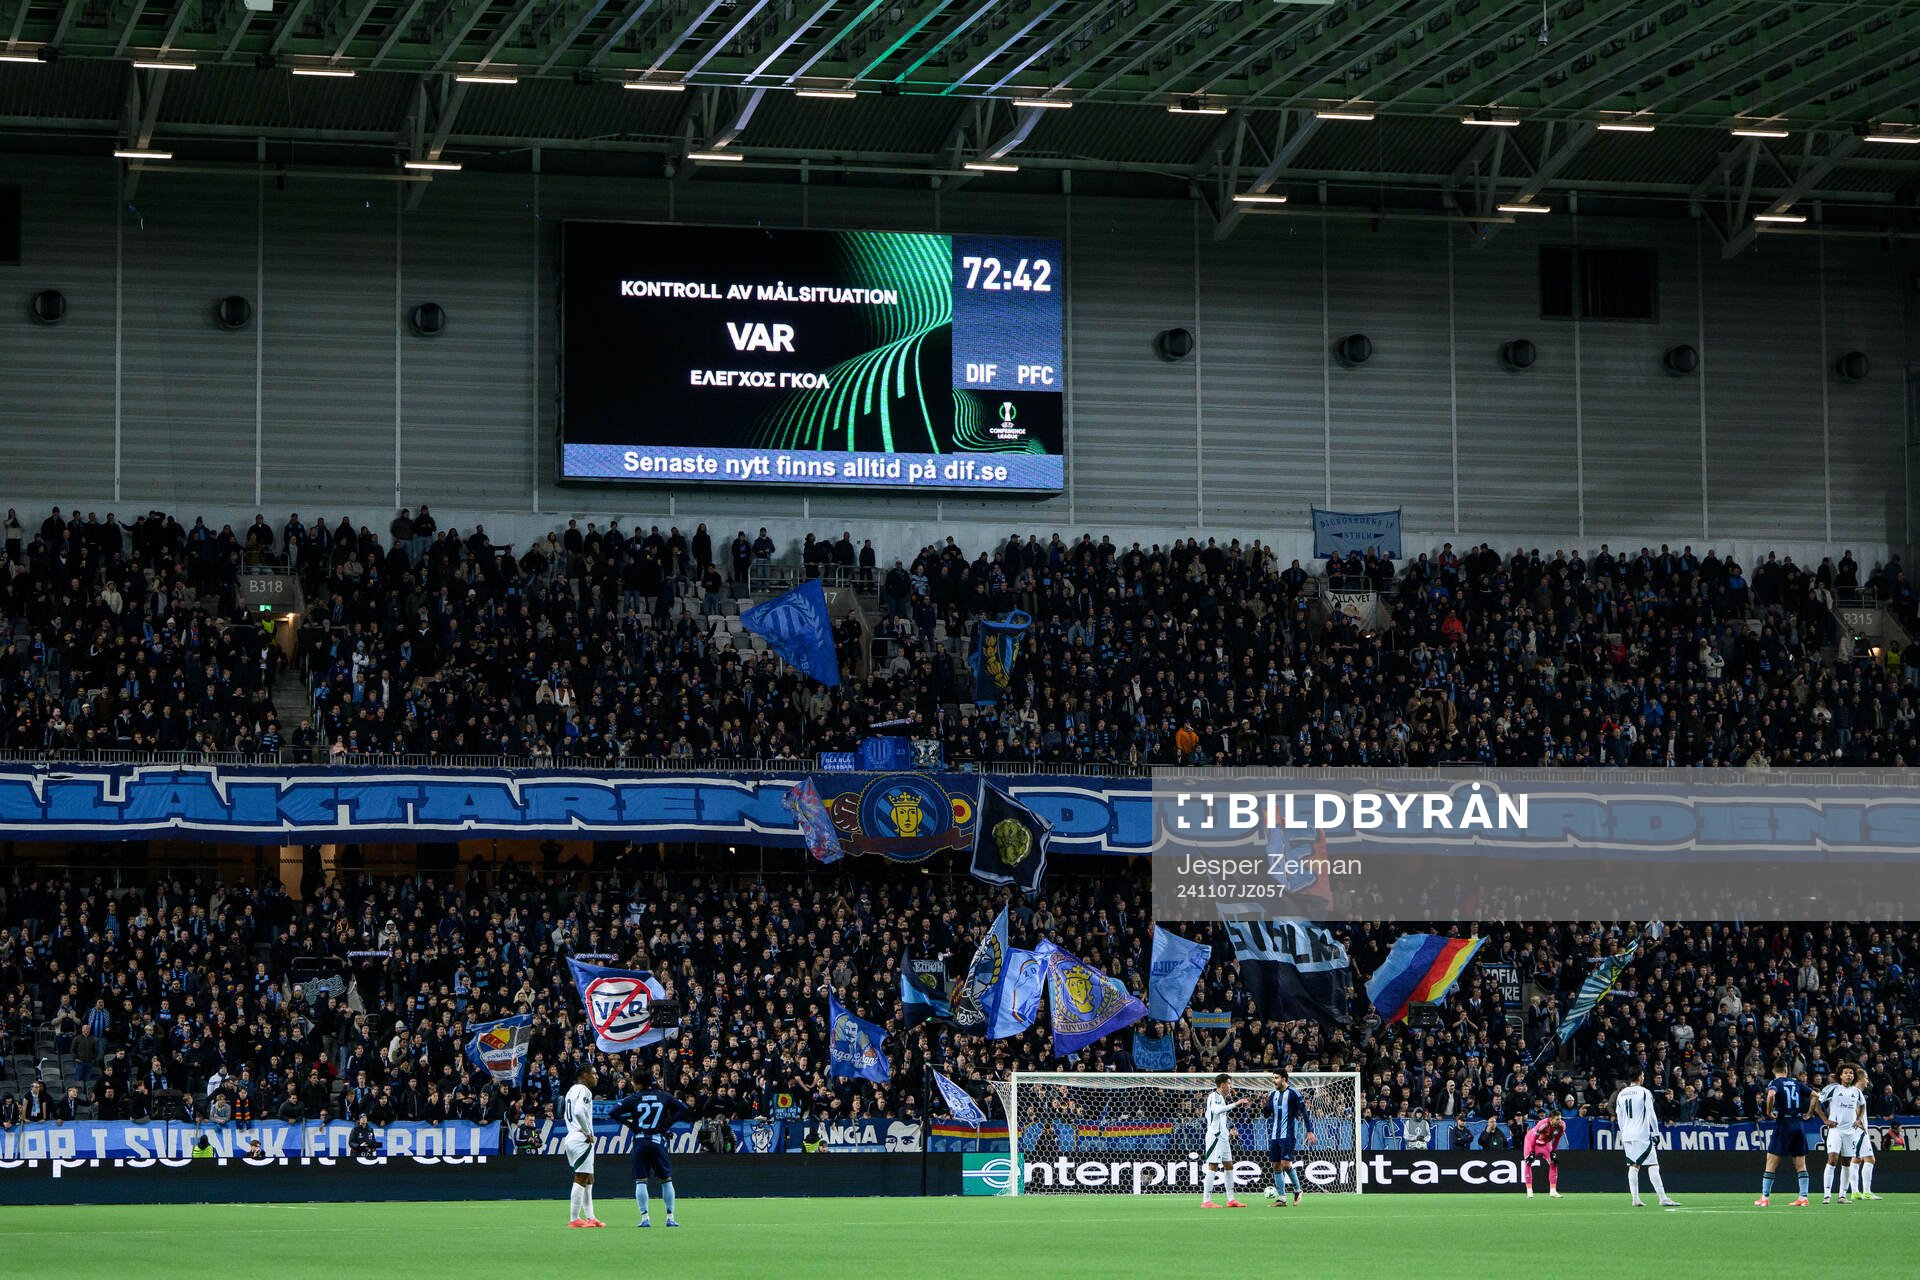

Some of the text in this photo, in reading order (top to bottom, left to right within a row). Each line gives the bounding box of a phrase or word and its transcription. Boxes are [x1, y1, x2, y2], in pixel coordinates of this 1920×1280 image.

[962, 256, 1052, 292] 72:42
[621, 280, 897, 305] KONTROLL AV MÅLSITUATION
[727, 322, 795, 352] VAR
[690, 369, 830, 389] ΕΛΕΓΧΟΣ ΓΚΟΛ
[966, 363, 1054, 386] DIF PFC
[623, 451, 1008, 483] Senaste nytt finns alltid på dif.se
[250, 580, 283, 593] B318
[1331, 593, 1371, 603] ALLA VET
[595, 1000, 644, 1020] VAR
[1624, 1098, 1633, 1119] 11
[1783, 1085, 1800, 1109] 14
[637, 1102, 664, 1129] 27
